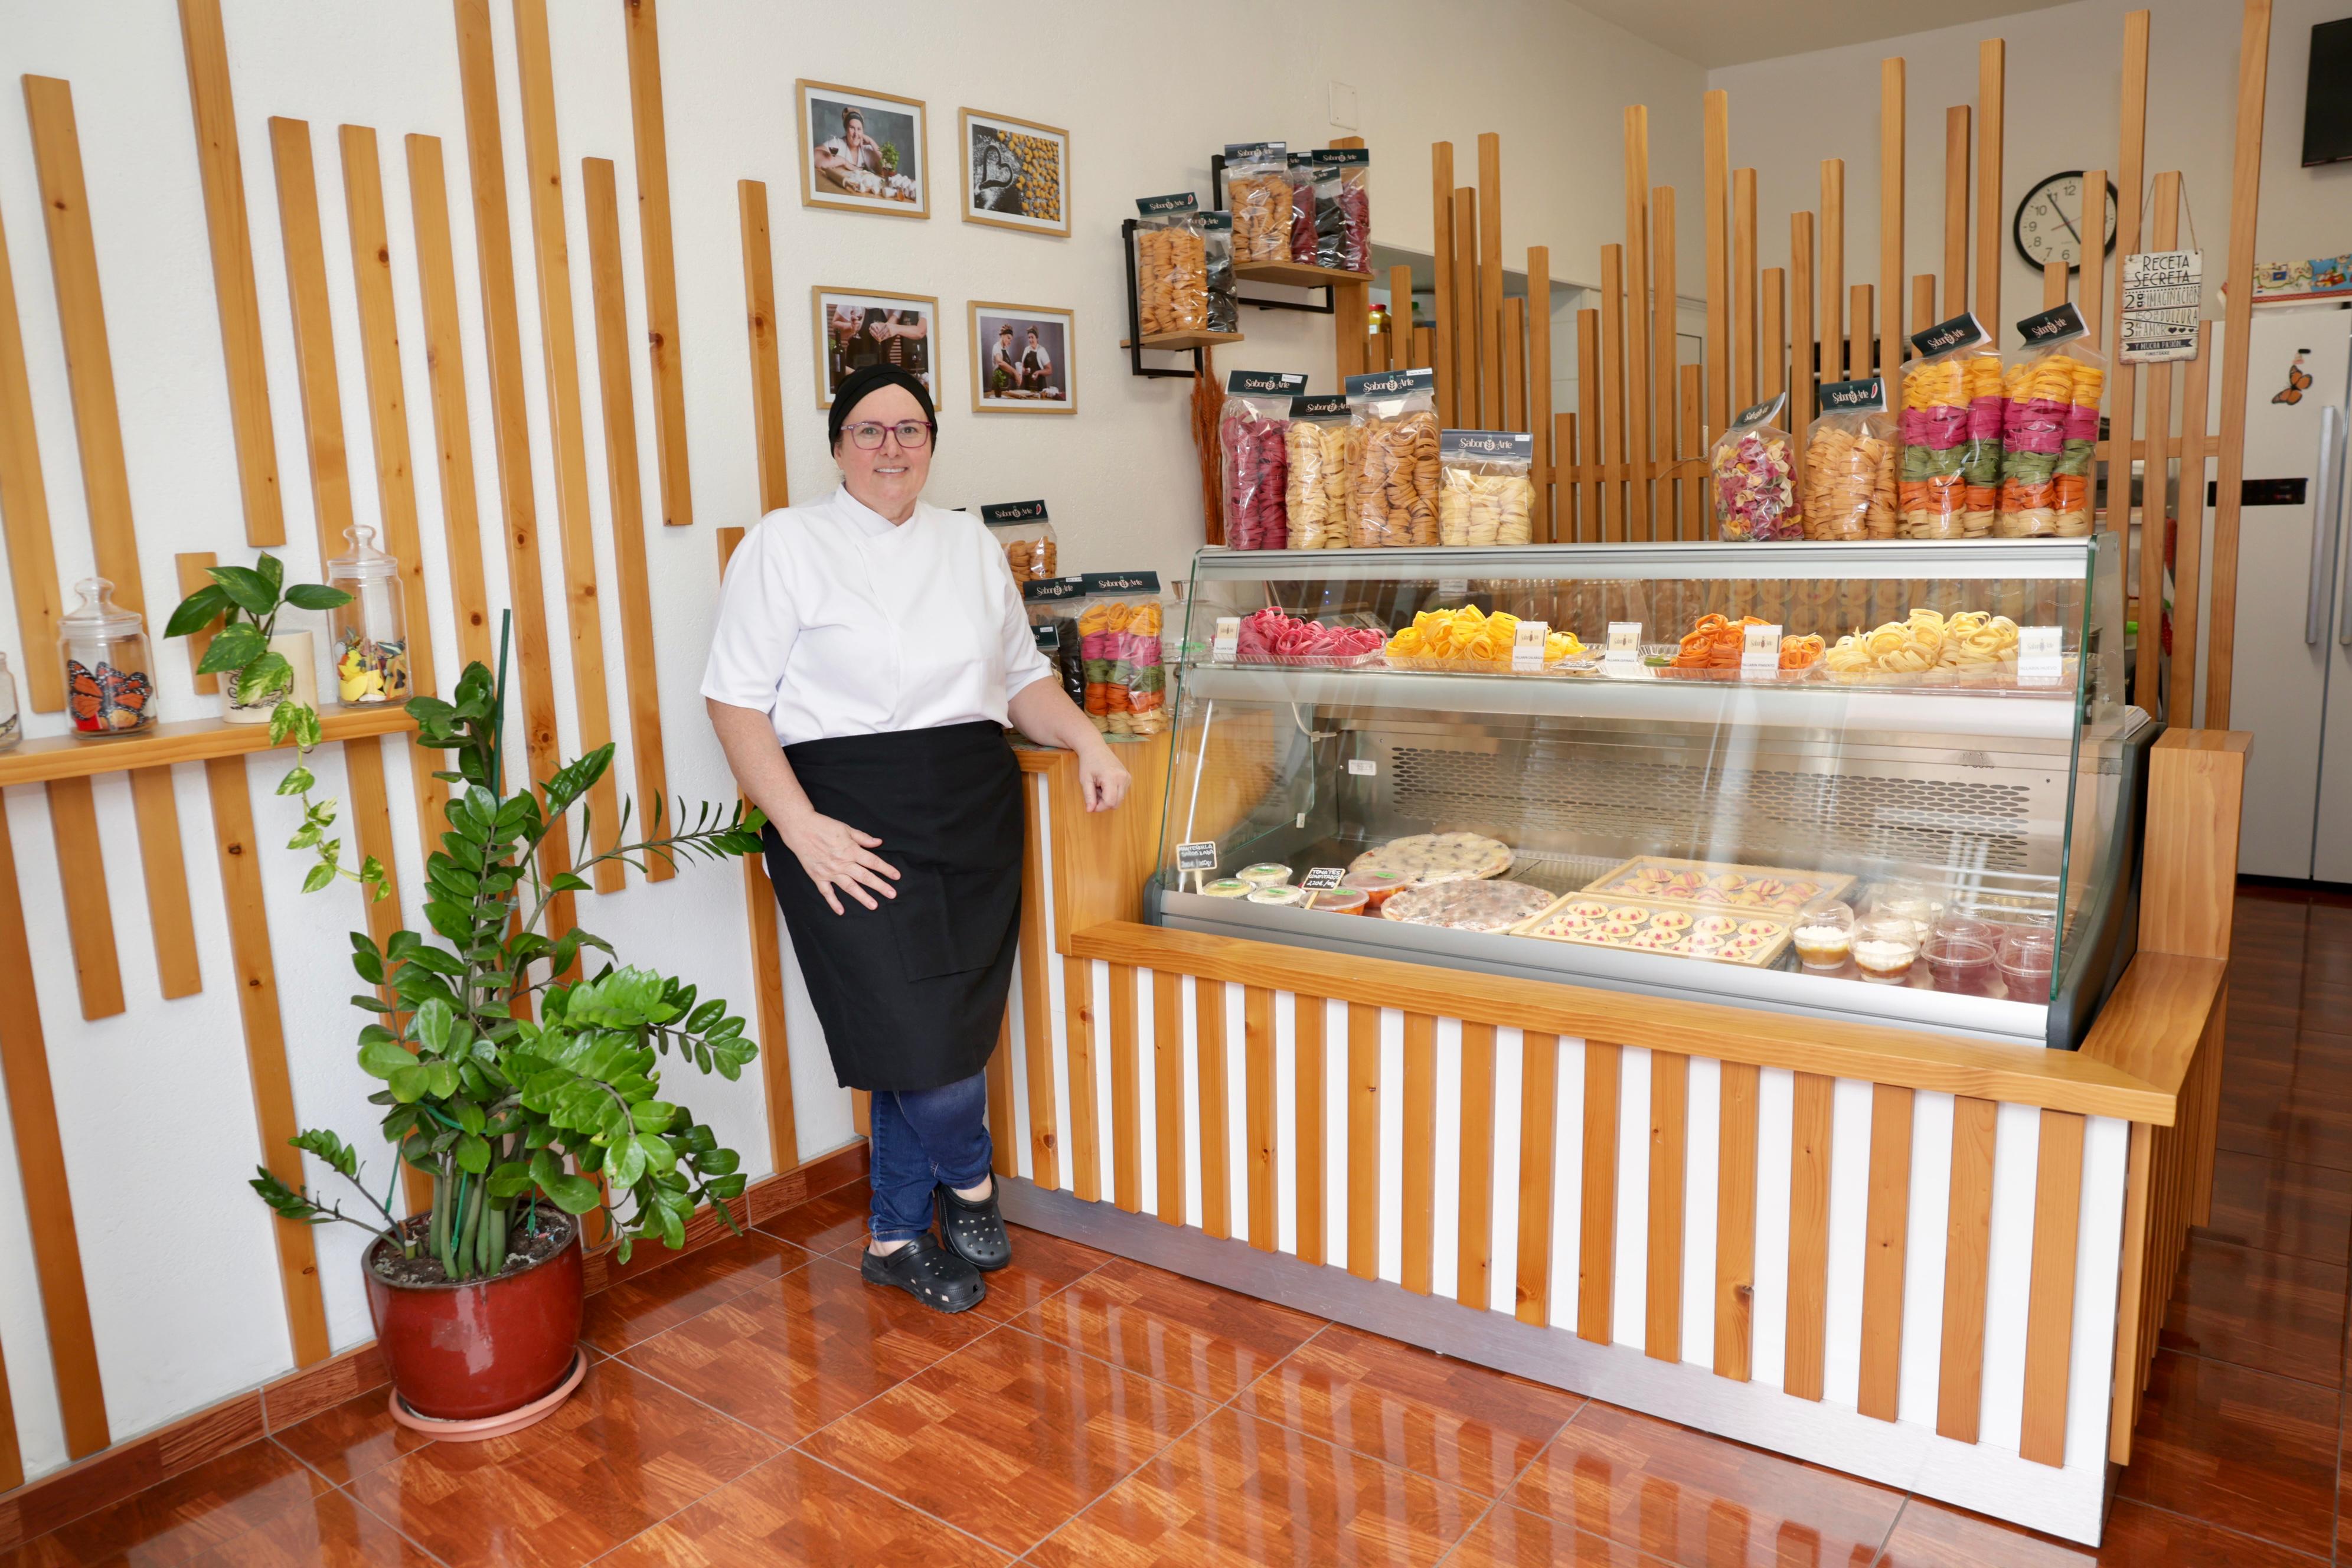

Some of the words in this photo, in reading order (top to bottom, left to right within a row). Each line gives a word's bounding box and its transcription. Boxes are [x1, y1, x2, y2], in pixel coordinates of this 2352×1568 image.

[2064, 185, 2076, 195] 12
[2035, 205, 2047, 215] 10
[2028, 221, 2037, 231] 9
[2033, 237, 2041, 247] 8
[2046, 247, 2053, 257] 7
[2062, 250, 2070, 260] 6
[2143, 255, 2190, 272] RECETA
[2134, 270, 2190, 288] SECRETA
[2125, 294, 2134, 309] 2
[2135, 311, 2152, 321] 150
[2160, 308, 2197, 324] DULZURA
[2124, 321, 2134, 337] 3
[2144, 323, 2167, 337] AMOR
[1244, 378, 1266, 388] Sabor
[1275, 381, 1290, 389] Arte
[1363, 381, 1388, 393] Sabor
[1398, 378, 1414, 389] Arte
[1832, 392, 1850, 404] Sabor
[1857, 390, 1868, 401] Arte
[1459, 437, 1485, 448] Sabor
[1495, 440, 1513, 450] Arte
[1036, 586, 1054, 596] Sabor
[1062, 584, 1073, 594] Arte
[1098, 580, 1120, 588] Sabor
